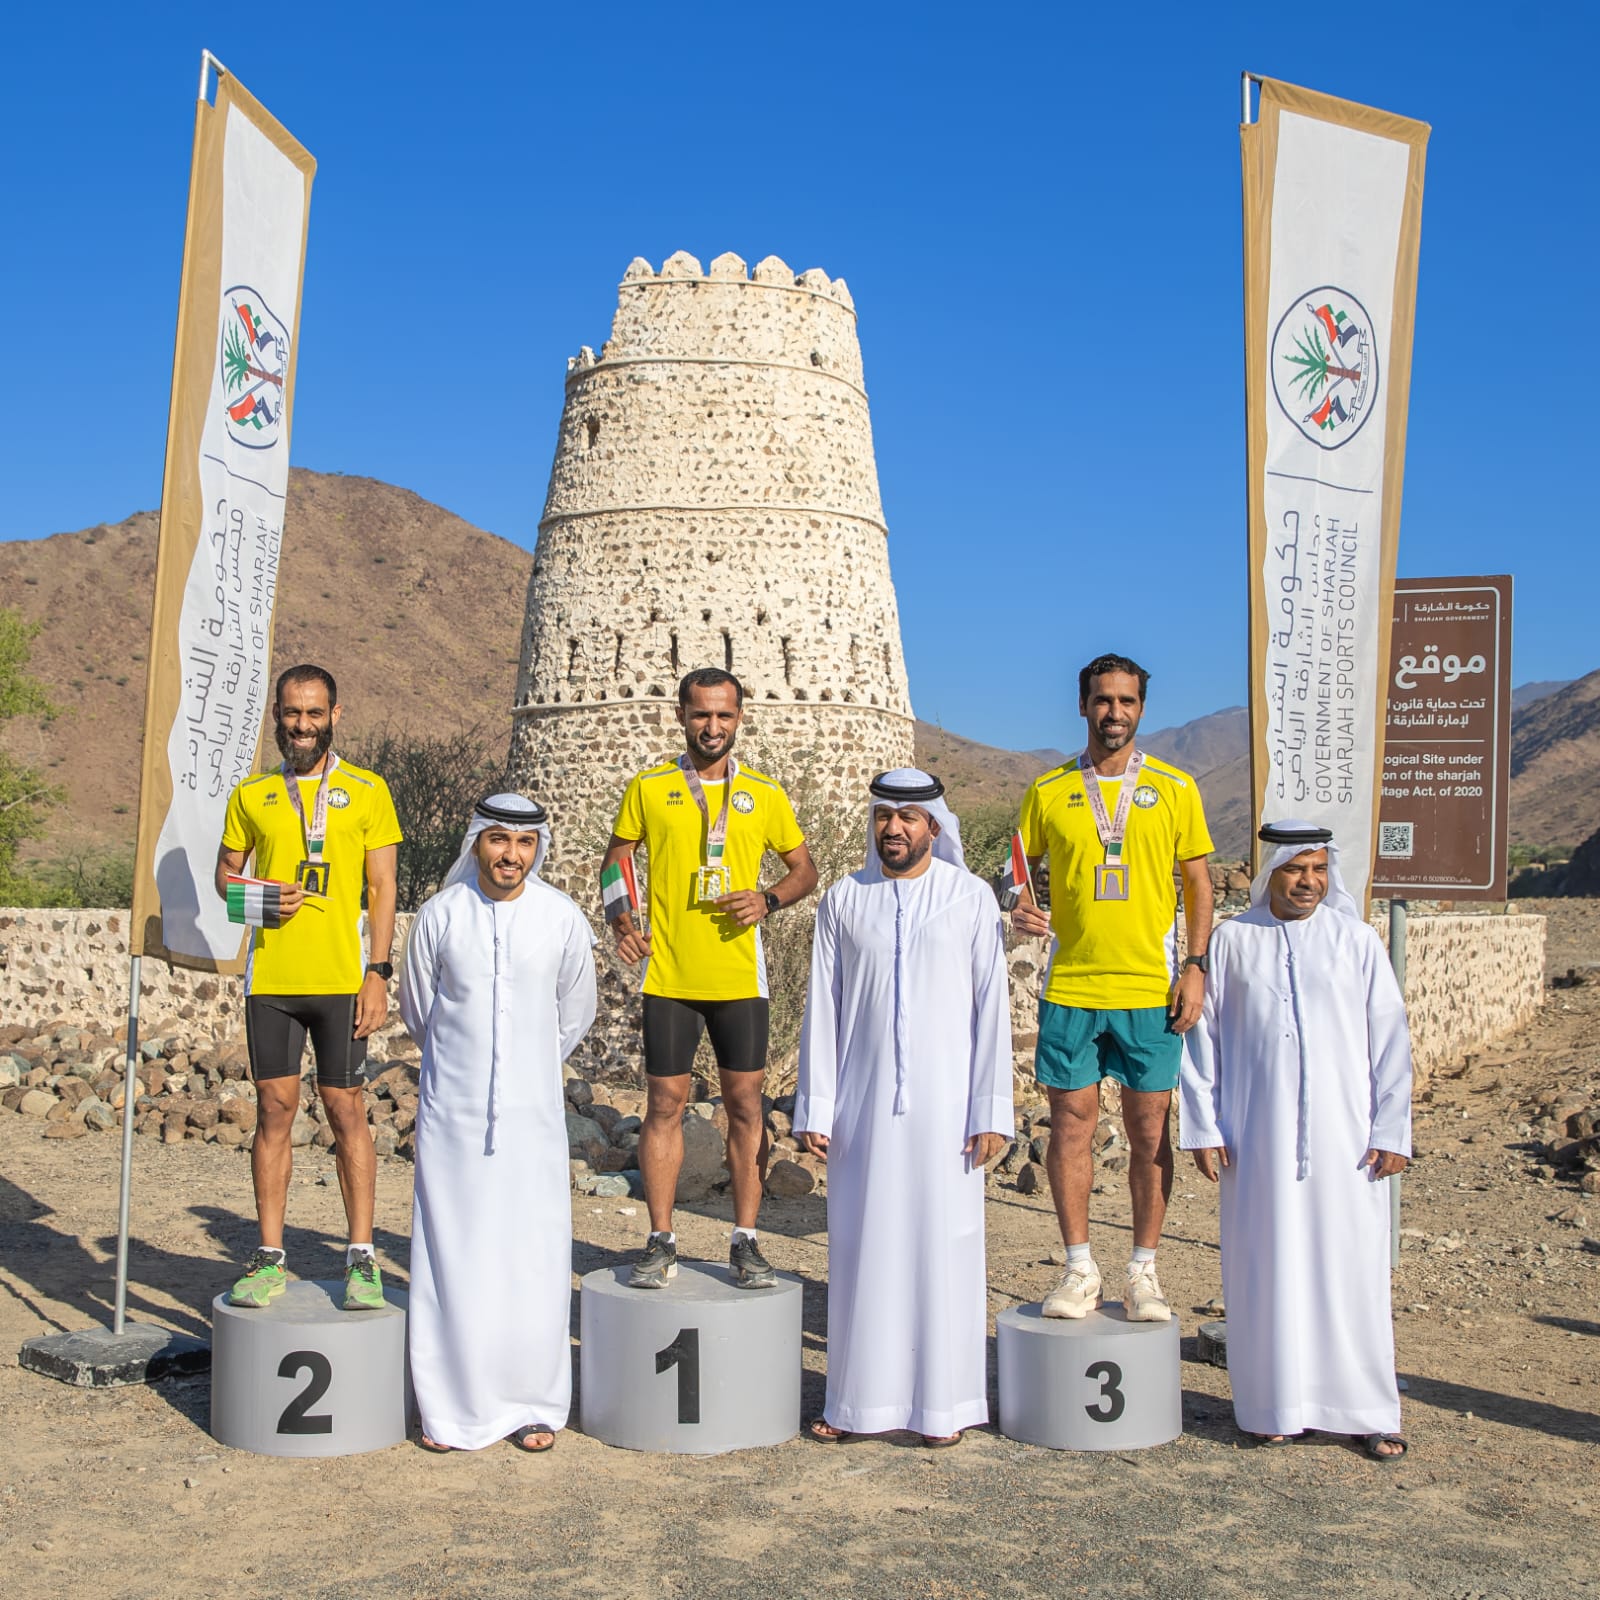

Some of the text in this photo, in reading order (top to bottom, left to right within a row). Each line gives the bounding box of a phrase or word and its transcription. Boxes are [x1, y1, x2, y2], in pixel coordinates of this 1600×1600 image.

[200, 498, 227, 637] حكومة
[249, 515, 268, 617] SHARJAH
[251, 621, 264, 650] OF
[1414, 602, 1490, 613] حكومة الشارقة
[221, 599, 247, 695] الشارقة
[1272, 510, 1302, 800] حكومة الشارقة
[1292, 608, 1314, 701] الشارقة
[1315, 518, 1340, 804] GOVERNMENT OF SHARJAH
[1336, 522, 1358, 804] SHARJAH SPORTS COUNCIL
[1394, 644, 1486, 690] موقع
[1392, 698, 1424, 712] قانون
[1393, 713, 1434, 728] الشارقة
[1426, 698, 1457, 712] حماية
[1459, 698, 1486, 709] تحت
[207, 703, 233, 798] الرياضي
[1287, 711, 1310, 802] الرياضي
[1382, 770, 1481, 782] on of the sharjah
[1384, 754, 1484, 766] ogical Site under
[1381, 786, 1483, 798] itage Act. of 2020
[276, 1350, 333, 1434] 2
[655, 1327, 700, 1425] 1
[1084, 1360, 1126, 1423] 3
